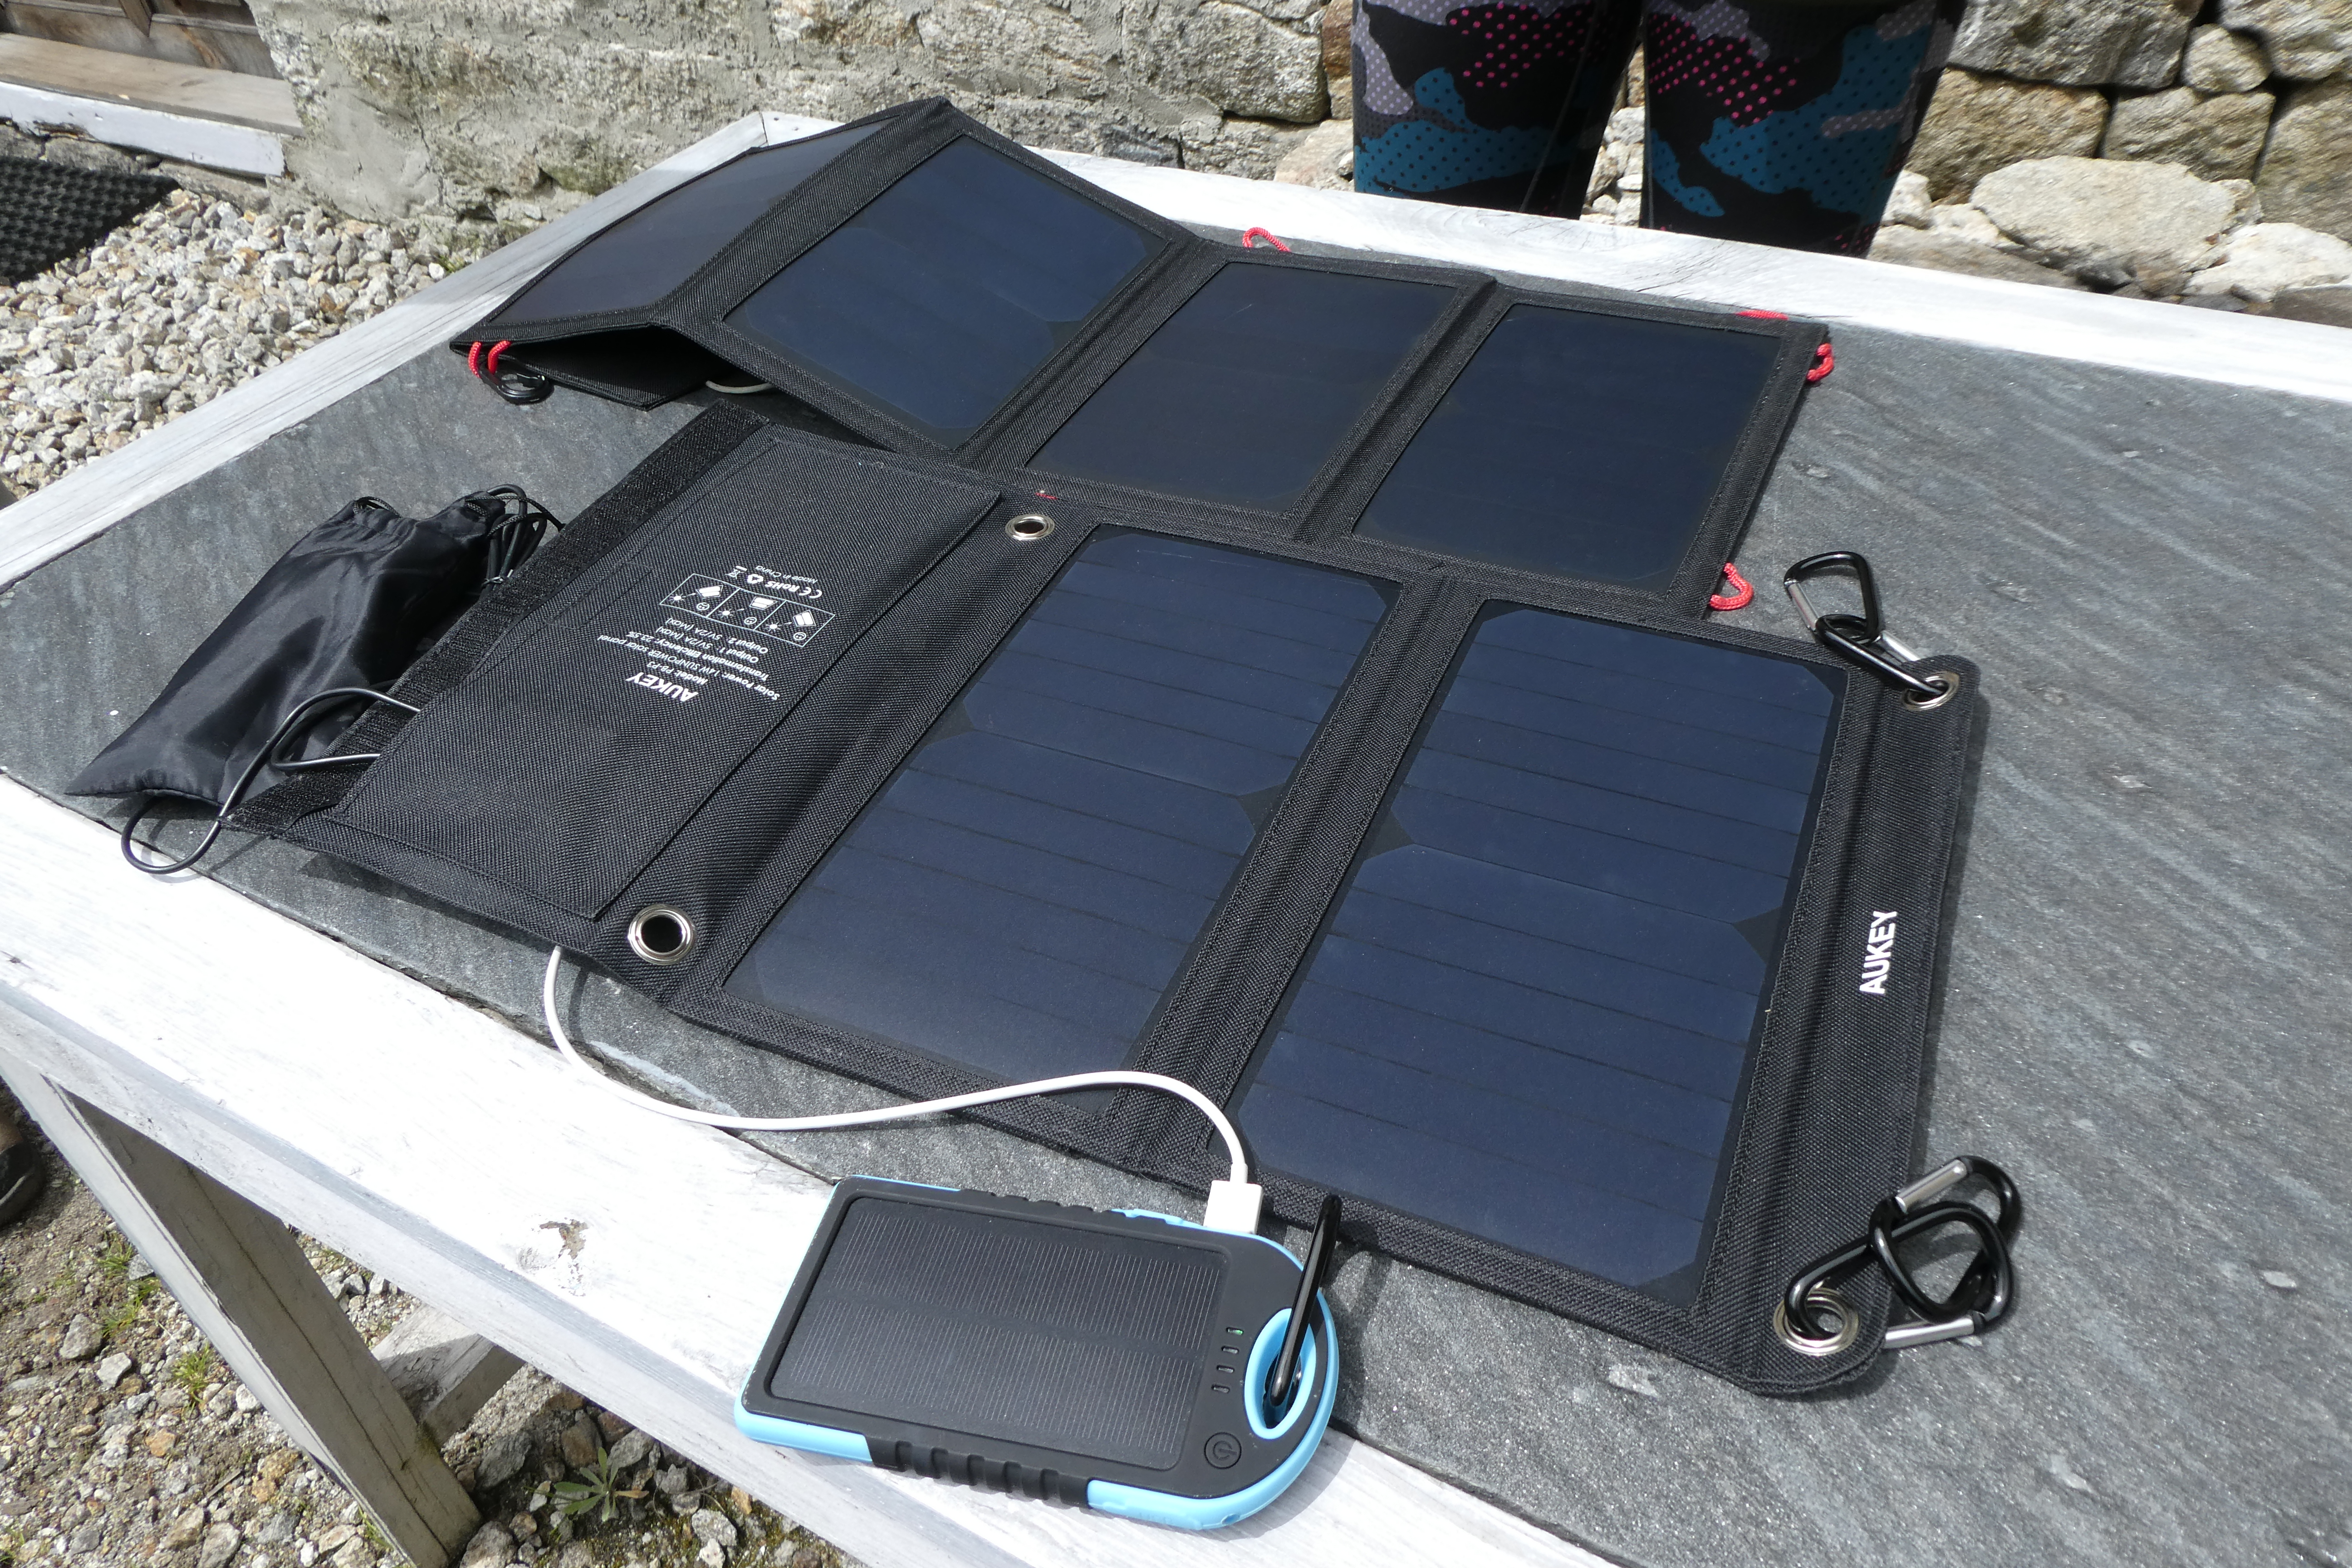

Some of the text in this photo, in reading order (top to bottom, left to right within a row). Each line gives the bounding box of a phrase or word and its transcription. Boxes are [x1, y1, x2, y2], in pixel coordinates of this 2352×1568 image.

[755, 566, 782, 578] China
[765, 581, 800, 592] RoHS
[791, 576, 818, 584] Made
[665, 617, 694, 631] (Max)
[656, 627, 684, 640] (Max)
[695, 627, 722, 640] 5V/2A
[685, 637, 713, 649] 5V/2A
[735, 640, 768, 654] Output
[626, 631, 769, 681] Transformation Efficiency: 23.5%
[726, 648, 759, 663] Output
[597, 634, 780, 700] Solar Power: 14W SUNPOWER solar panel
[674, 670, 708, 685] Model:
[625, 672, 699, 702] AUKEY
[1859, 911, 1897, 994] AUKEY
